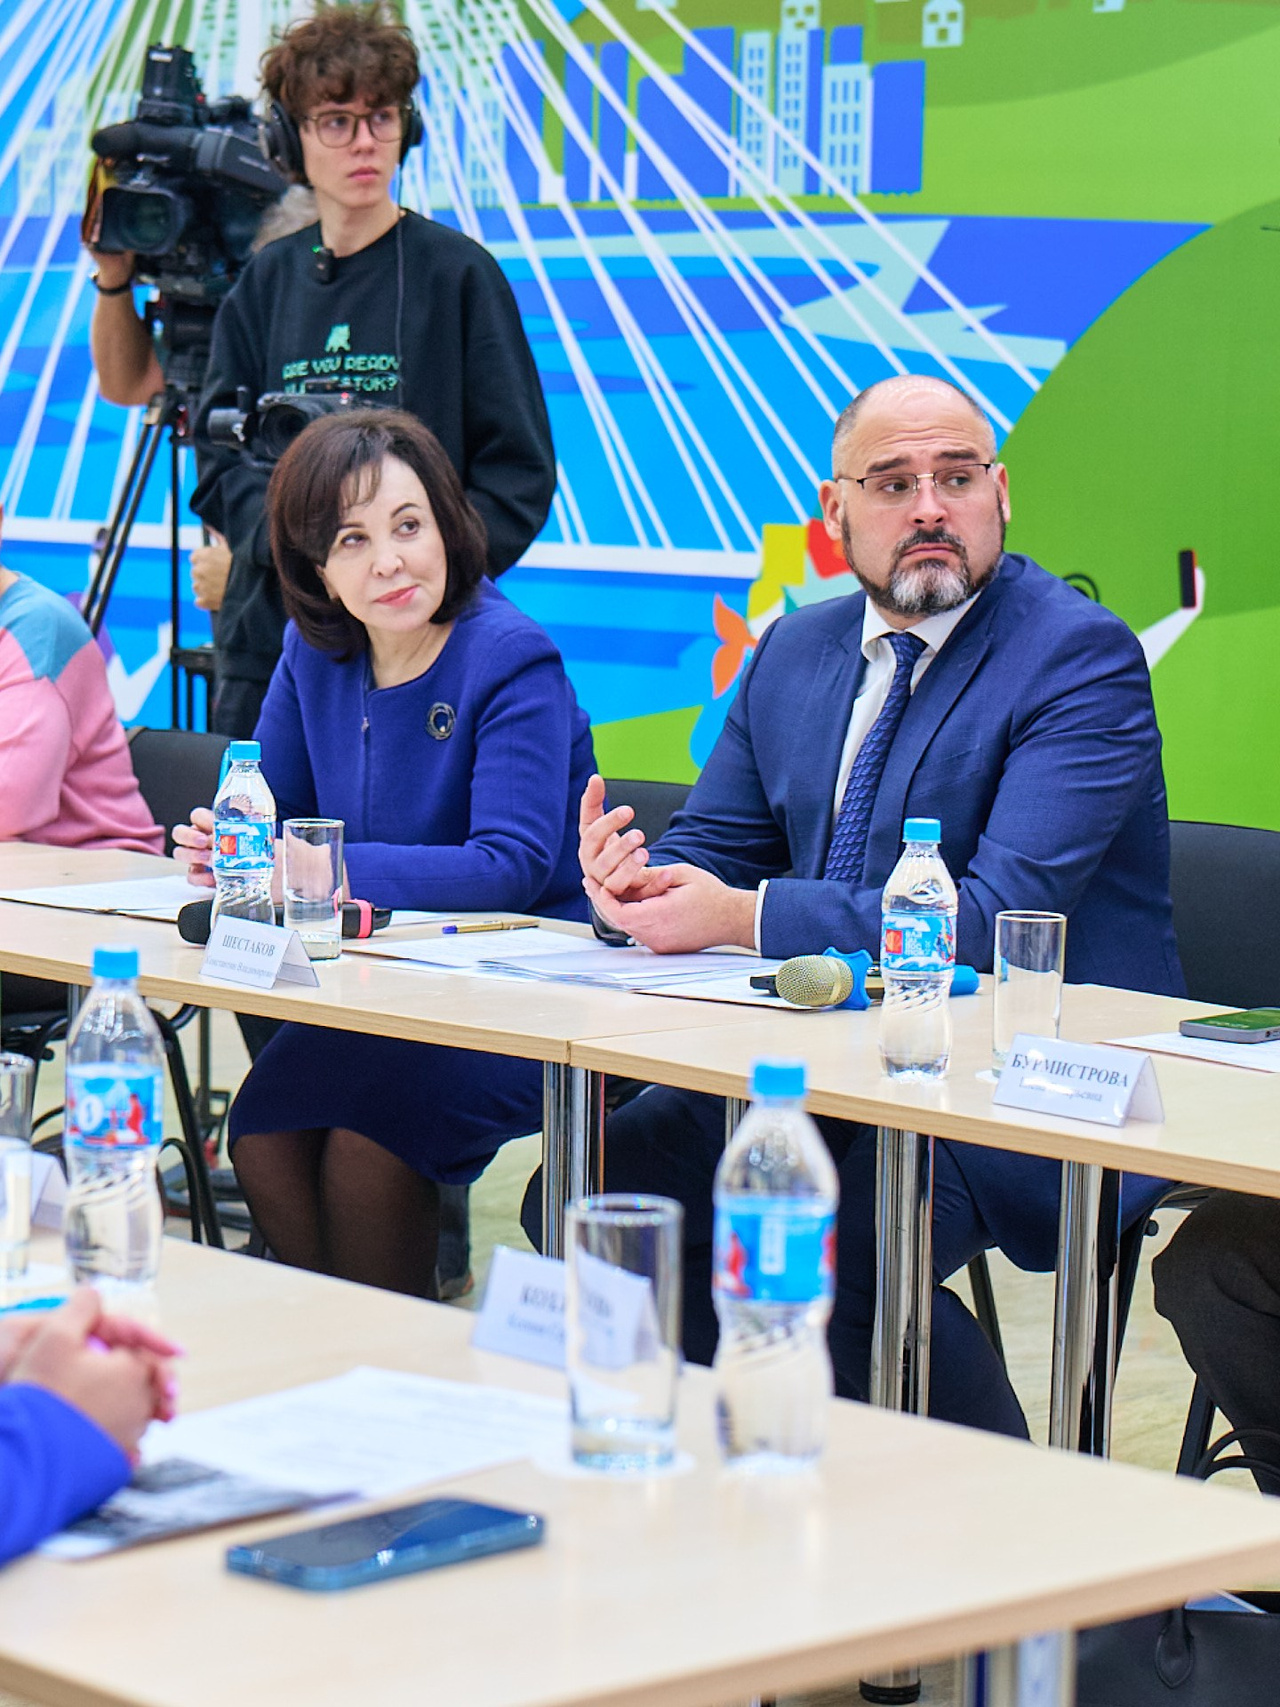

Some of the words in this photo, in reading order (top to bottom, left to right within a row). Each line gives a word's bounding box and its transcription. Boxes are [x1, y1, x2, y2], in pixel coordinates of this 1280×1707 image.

[344, 354, 400, 371] READY
[222, 933, 276, 957] ШЕСТАКОВ
[1011, 1052, 1129, 1088] БУРМИСТРОВА
